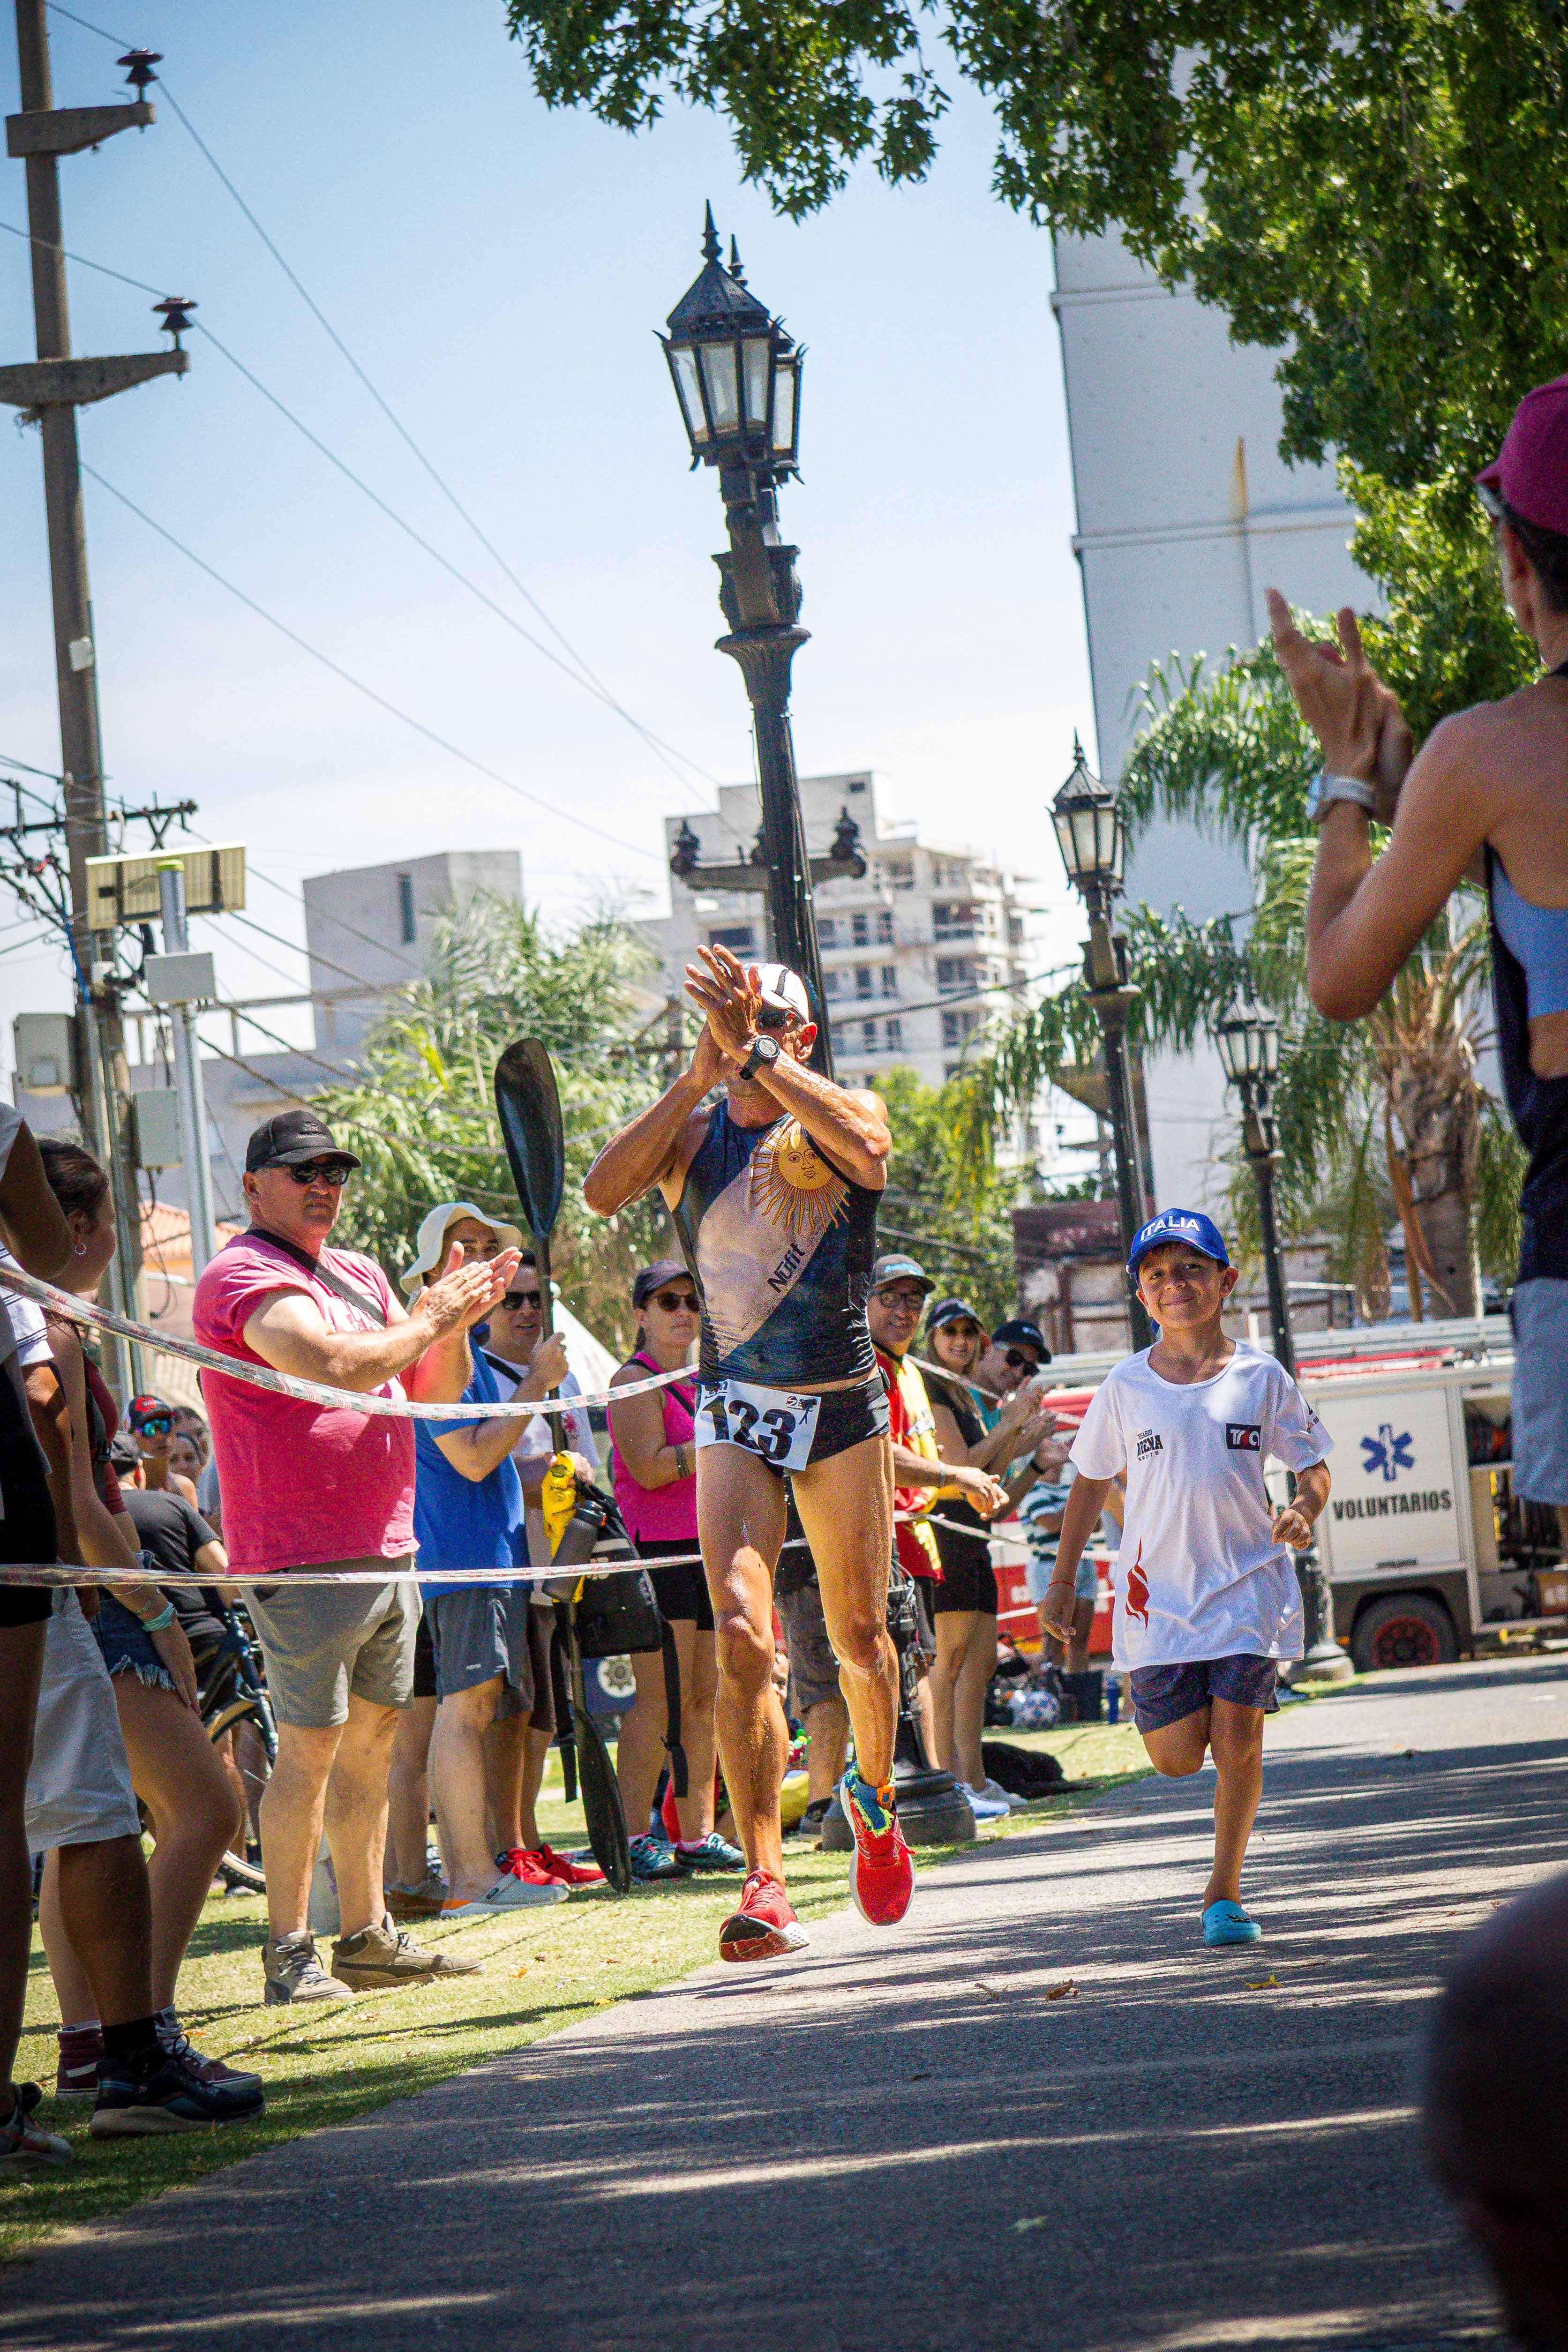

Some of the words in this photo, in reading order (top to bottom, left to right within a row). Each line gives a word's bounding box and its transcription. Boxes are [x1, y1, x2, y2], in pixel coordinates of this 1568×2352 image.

[1140, 1216, 1200, 1241] ITALIA
[702, 1395, 796, 1461] 123
[1333, 1489, 1452, 1521] VOLUNTARIOS
